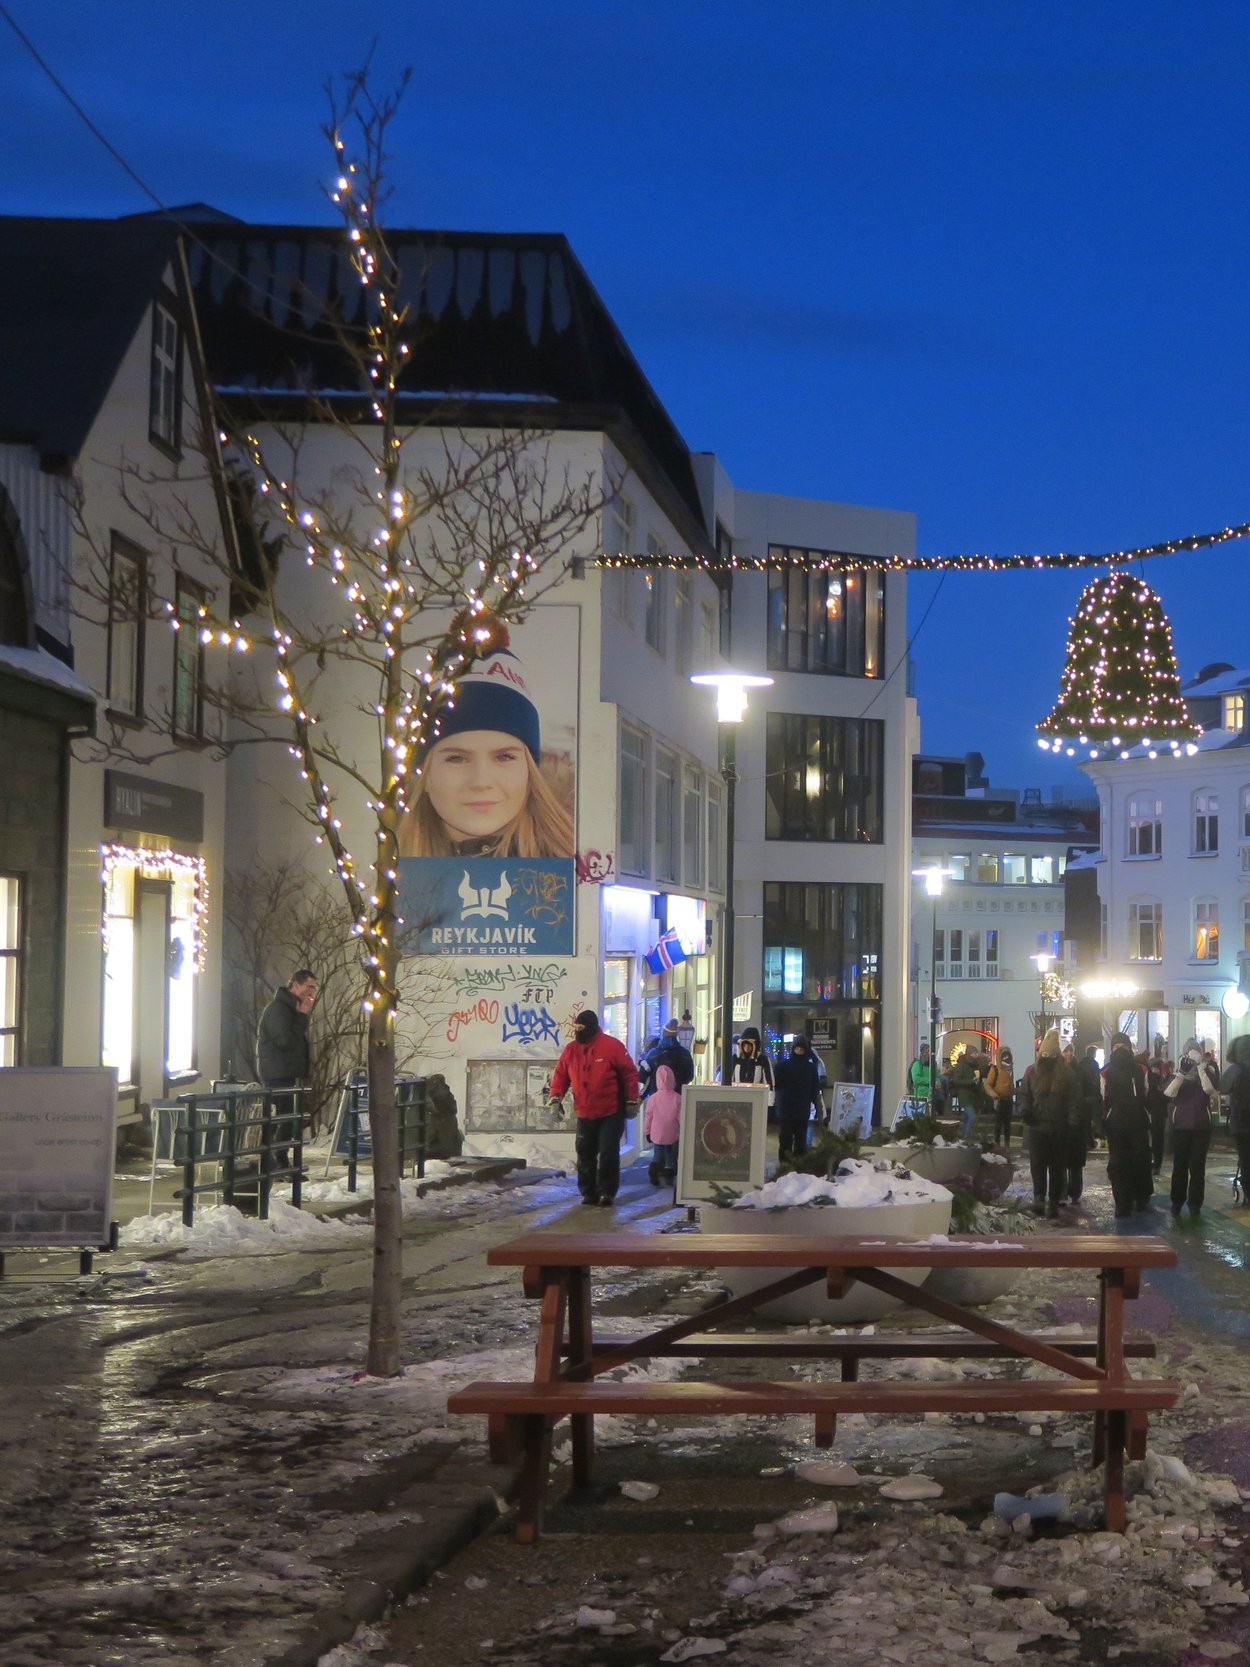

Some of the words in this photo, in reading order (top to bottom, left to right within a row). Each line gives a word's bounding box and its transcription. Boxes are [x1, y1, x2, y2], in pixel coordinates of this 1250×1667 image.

[431, 923, 537, 945] REYKJAVÍK
[441, 946, 474, 954] GIFT
[479, 946, 528, 954] STORE
